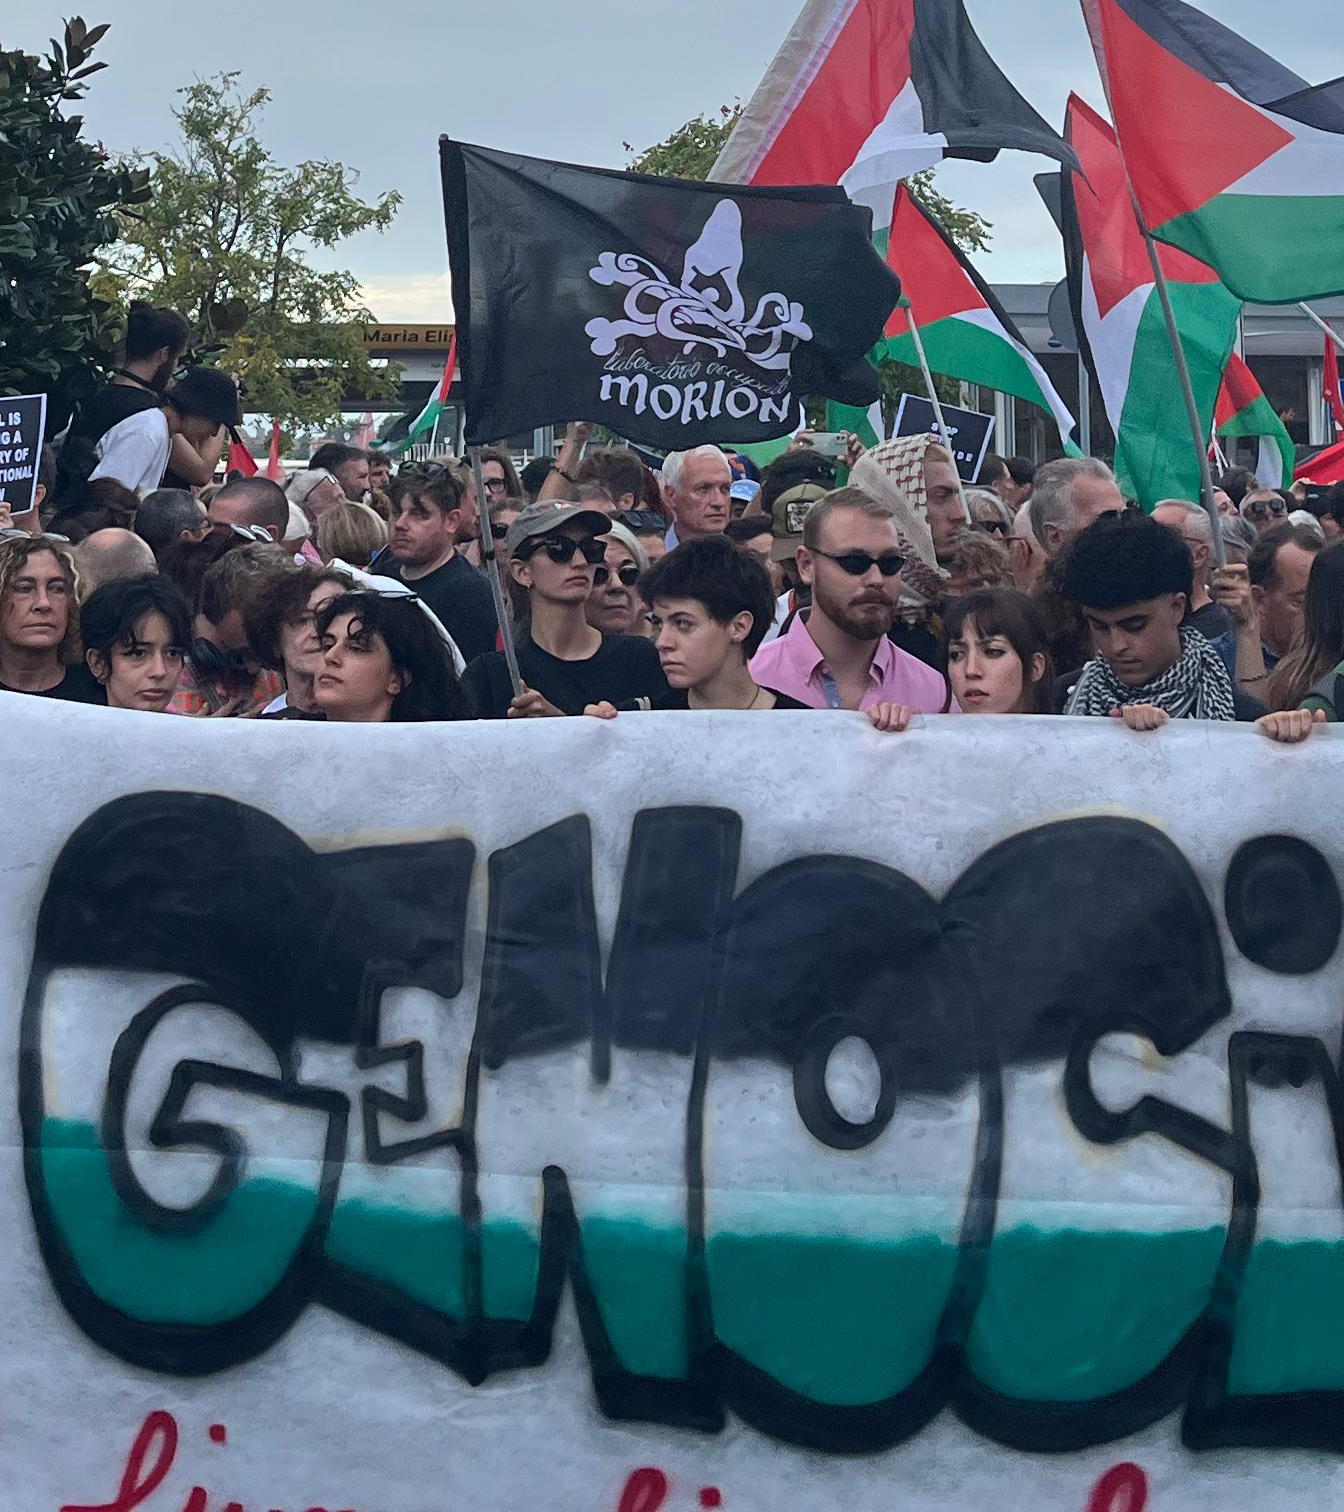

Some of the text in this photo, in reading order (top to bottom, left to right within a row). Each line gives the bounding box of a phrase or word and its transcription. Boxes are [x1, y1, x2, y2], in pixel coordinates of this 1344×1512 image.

[363, 330, 419, 344] Maria
[8, 411, 22, 426] IS
[931, 423, 958, 435] SOP
[14, 430, 23, 444] A
[14, 447, 30, 462] OF
